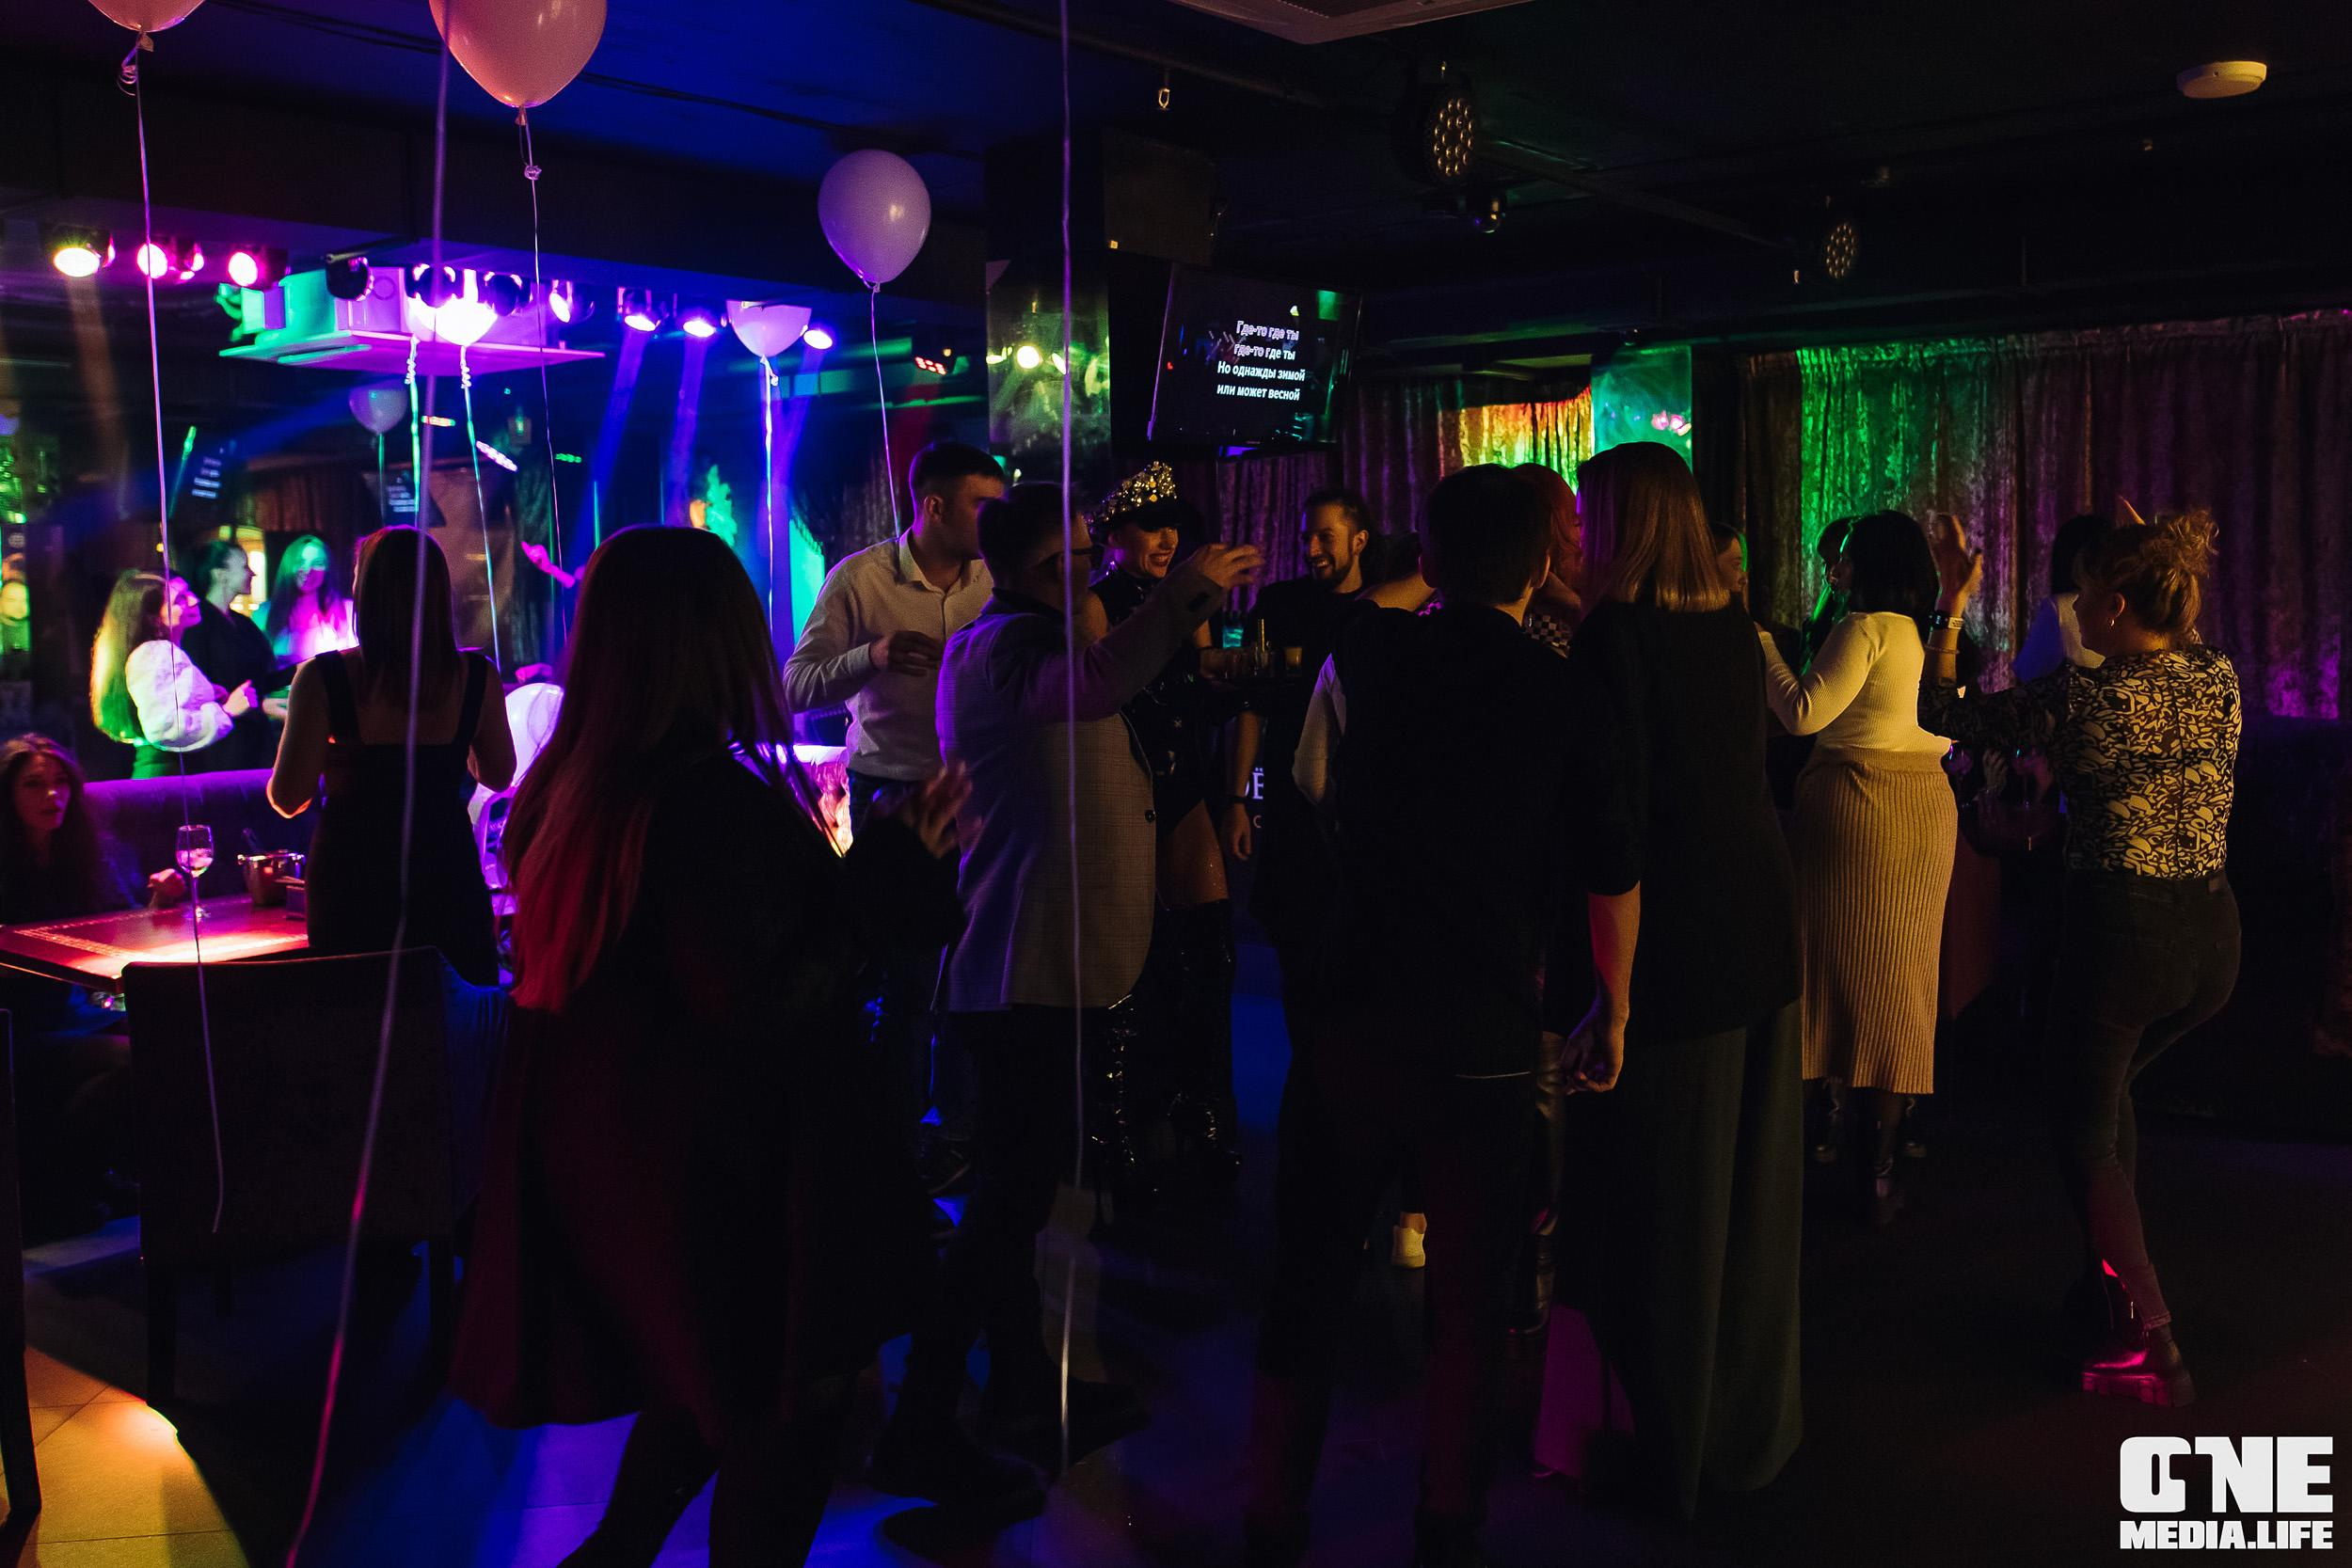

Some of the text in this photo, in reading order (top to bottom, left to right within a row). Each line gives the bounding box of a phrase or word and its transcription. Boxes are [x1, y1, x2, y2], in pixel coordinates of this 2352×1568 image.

[1235, 321, 1299, 341] Где-то где ты
[1233, 343, 1295, 360] где-то где ты
[1217, 360, 1306, 381] Но однажды зимой
[1216, 384, 1300, 401] или может весной
